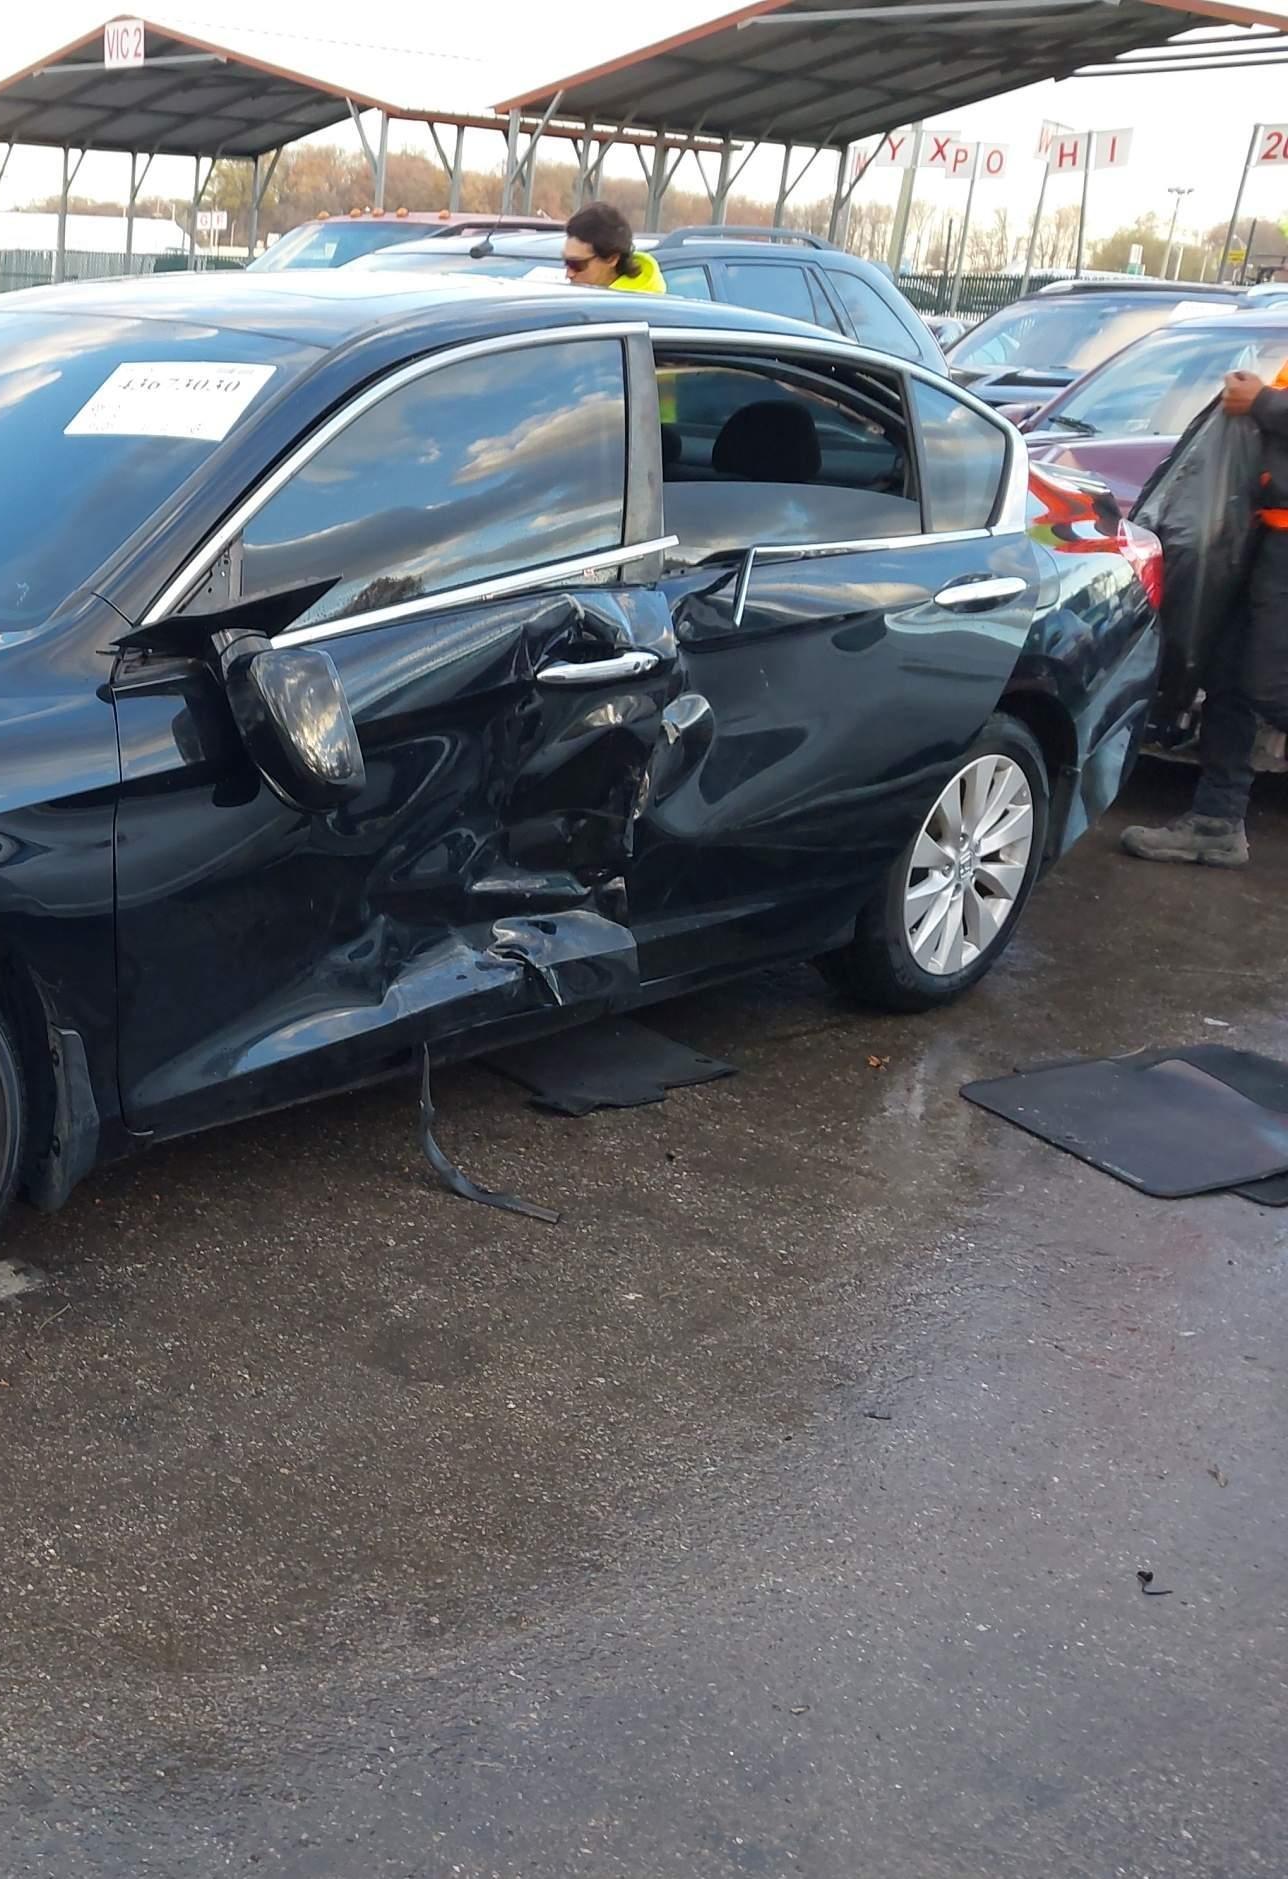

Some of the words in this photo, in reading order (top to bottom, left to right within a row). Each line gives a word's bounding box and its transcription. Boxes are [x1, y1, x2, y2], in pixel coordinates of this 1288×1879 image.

[106, 28, 130, 60] VIC
[133, 27, 142, 58] 2
[887, 137, 906, 161] Y
[929, 136, 951, 162] X
[952, 148, 968, 173] P
[986, 149, 1004, 174] O
[1058, 140, 1078, 168] H
[1109, 136, 1117, 163] I
